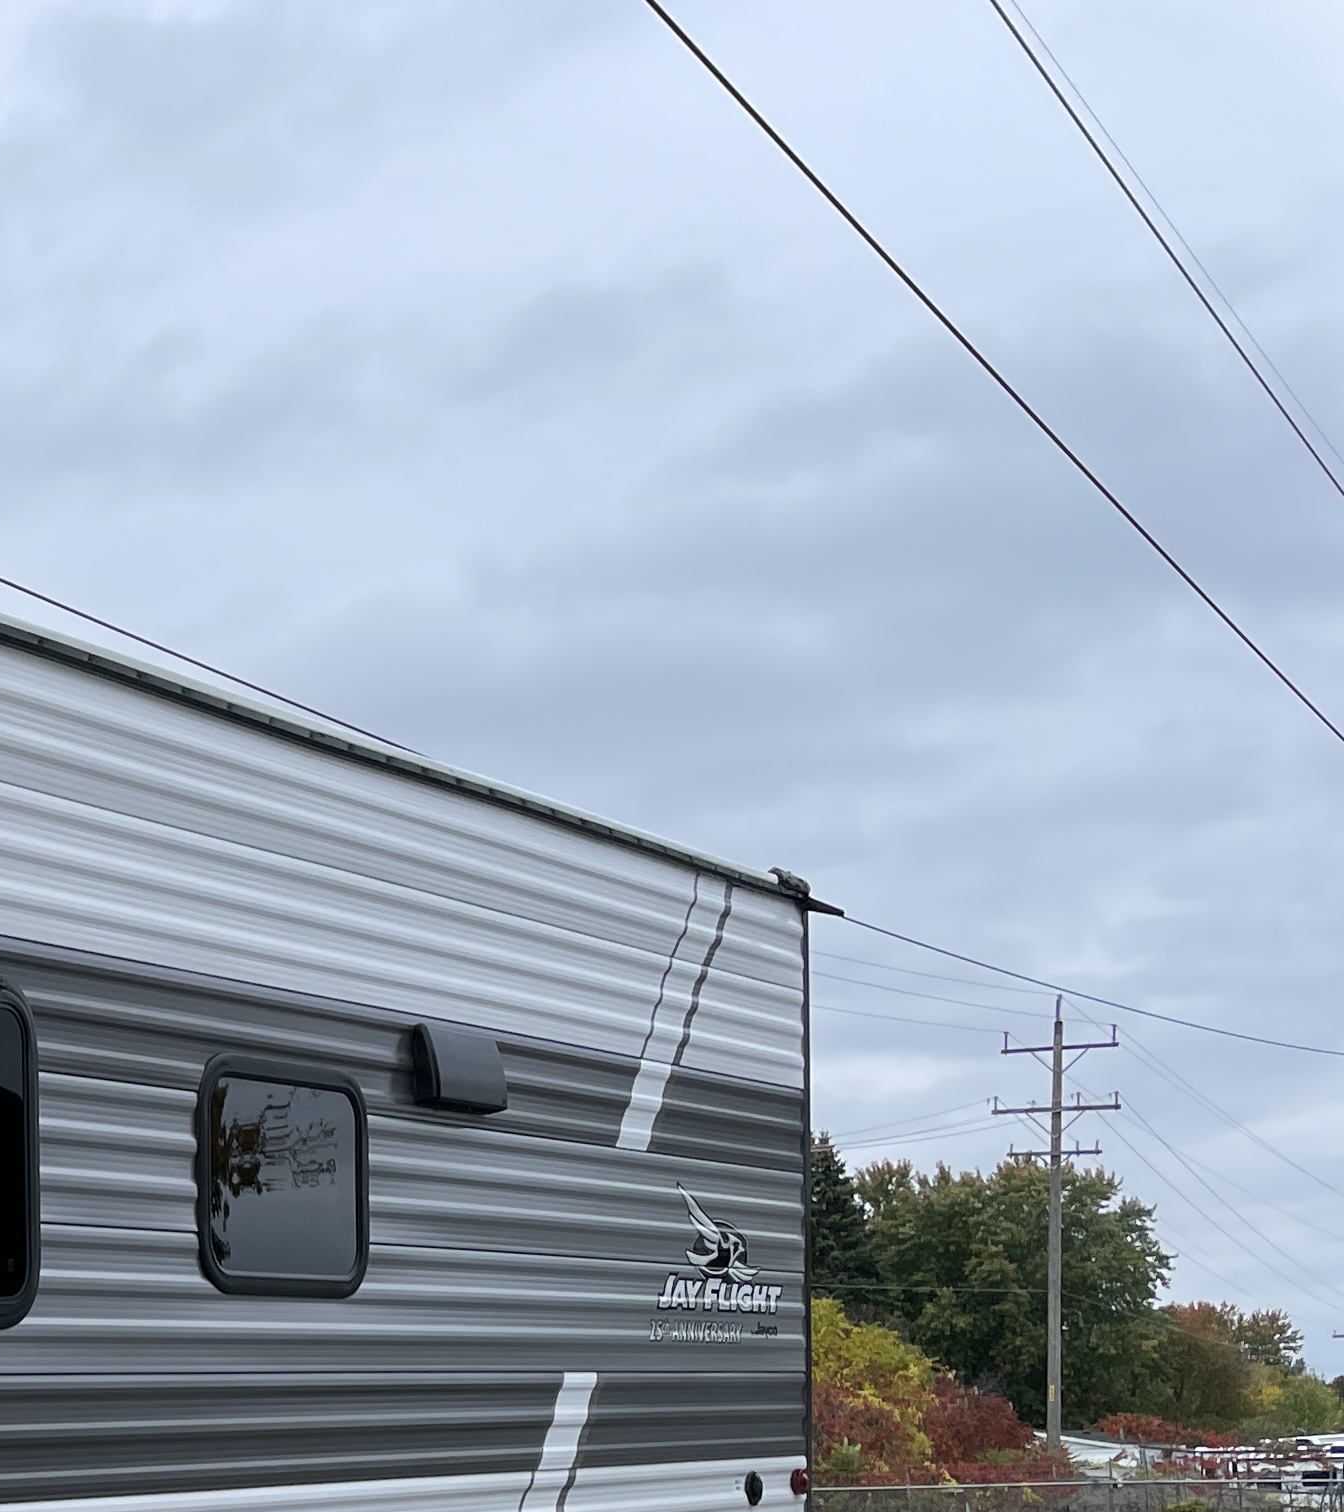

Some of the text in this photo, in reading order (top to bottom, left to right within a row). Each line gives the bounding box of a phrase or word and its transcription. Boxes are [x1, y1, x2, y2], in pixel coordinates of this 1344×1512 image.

[657, 1272, 783, 1315] JAY FLIGHT
[672, 1318, 743, 1344] ANNIVERSARY
